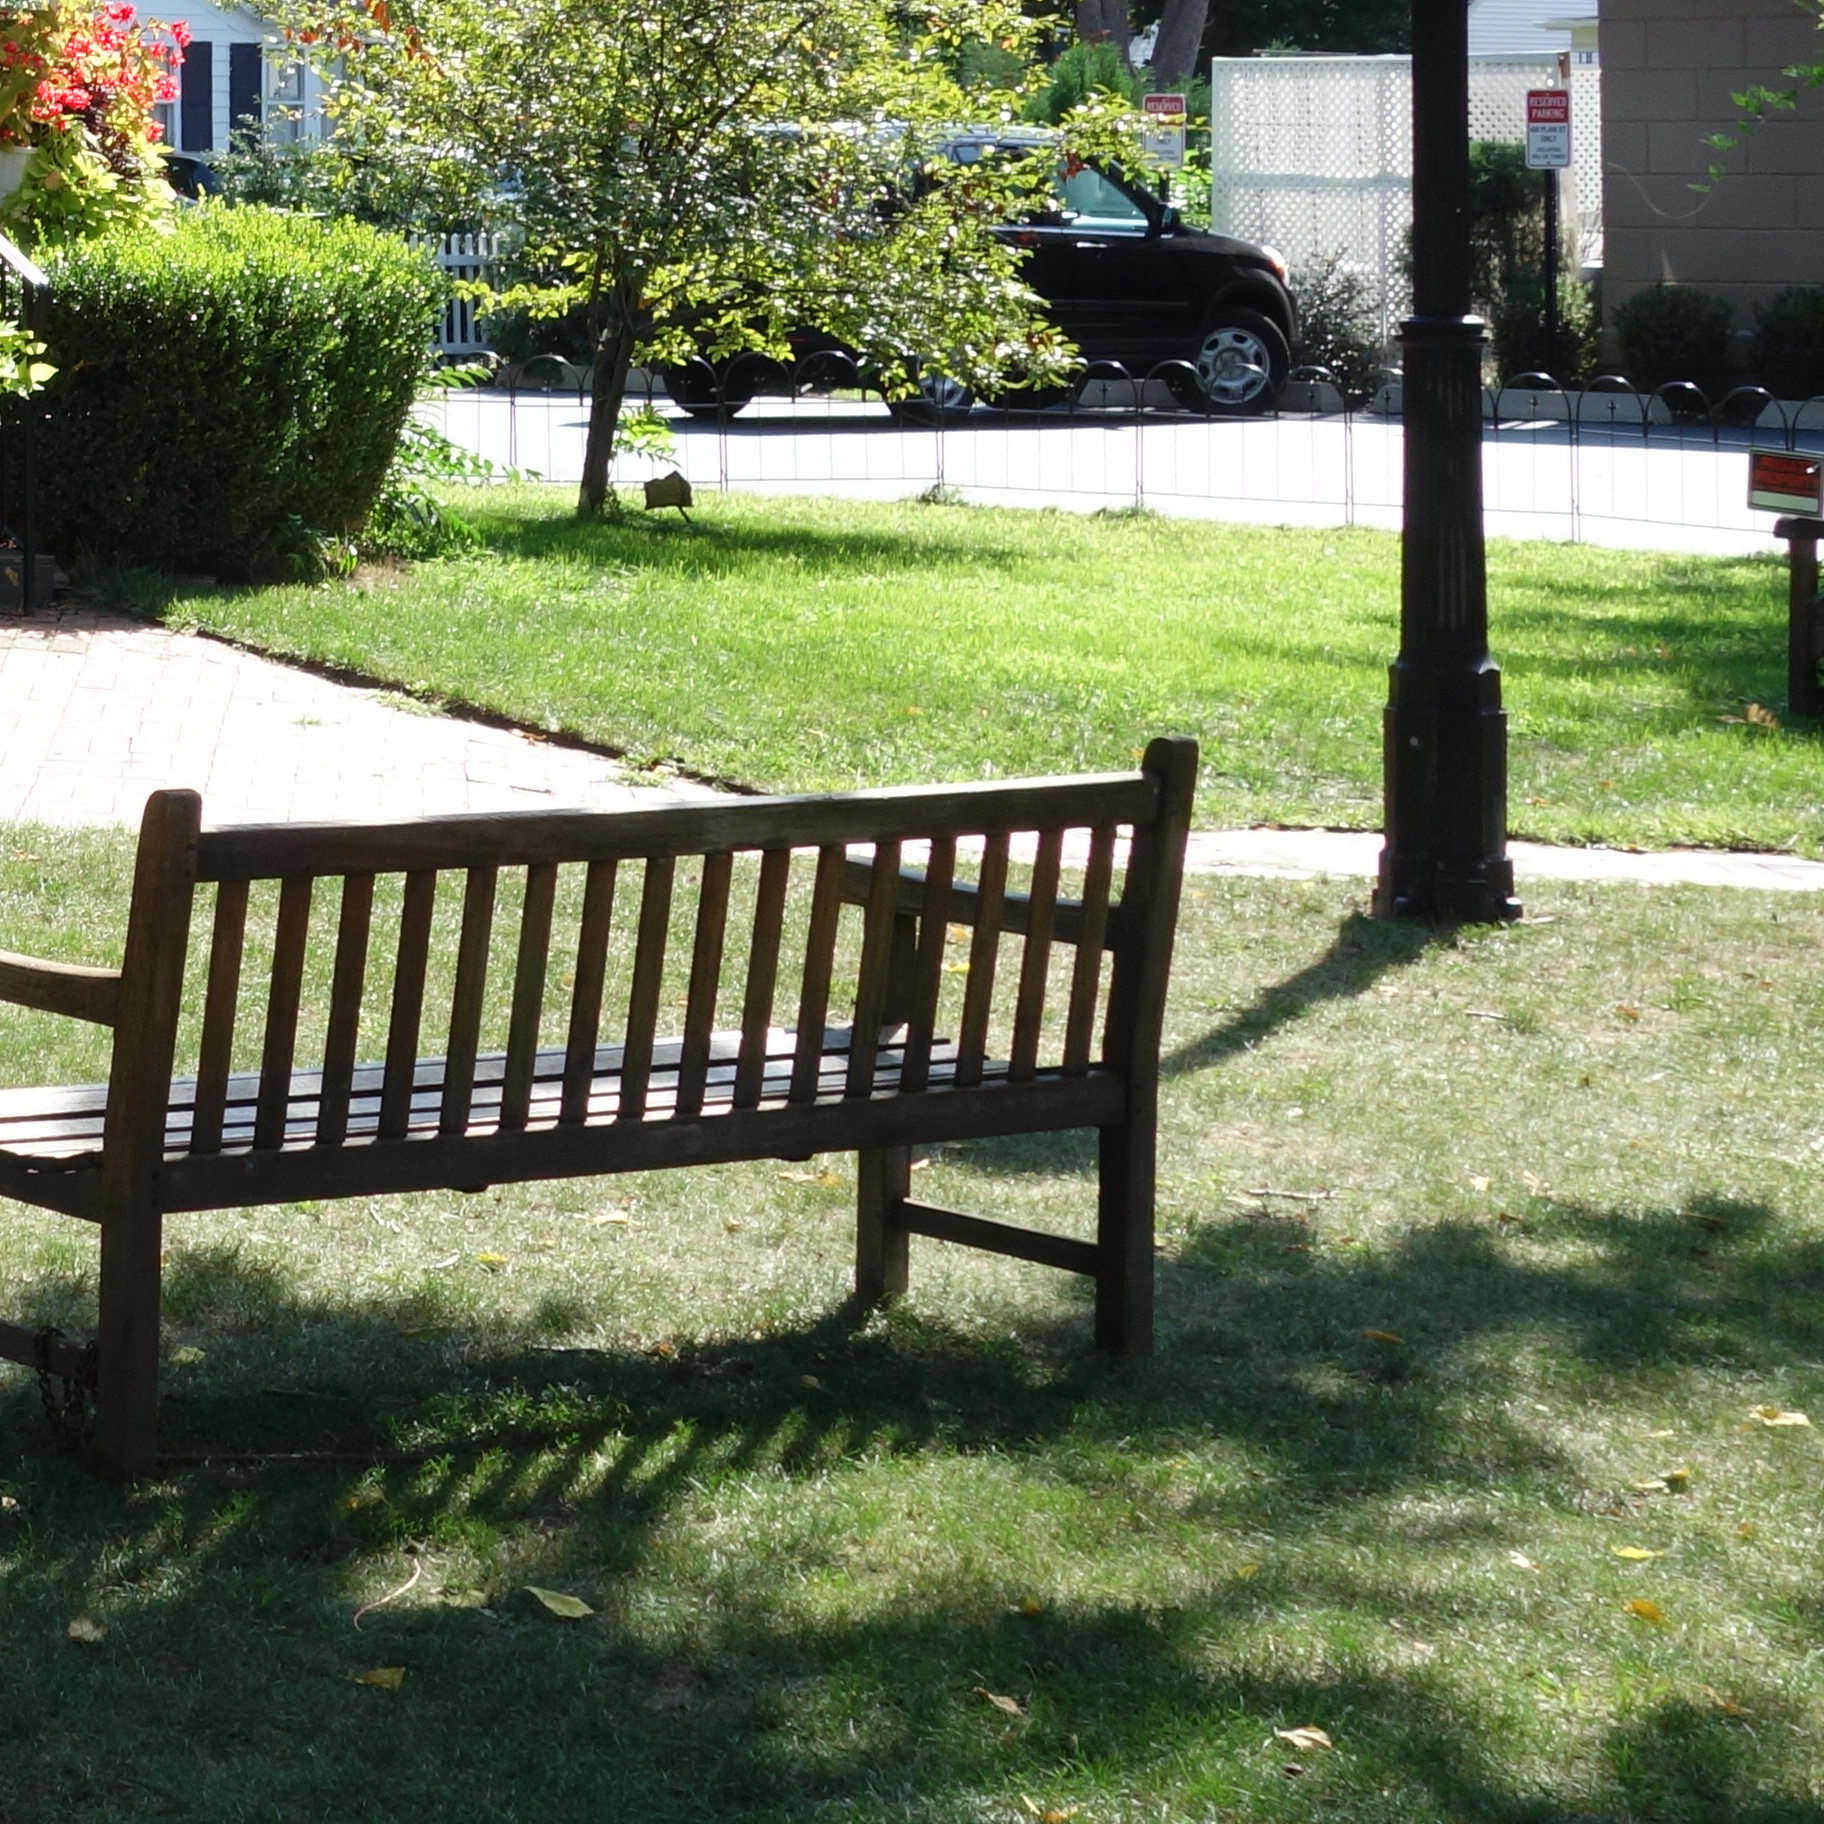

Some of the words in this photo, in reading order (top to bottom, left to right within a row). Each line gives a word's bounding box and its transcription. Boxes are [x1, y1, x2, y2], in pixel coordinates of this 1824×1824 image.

[1147, 102, 1182, 112] RESERVED
[1530, 97, 1567, 107] RESERVED
[1532, 108, 1565, 119] PARKING
